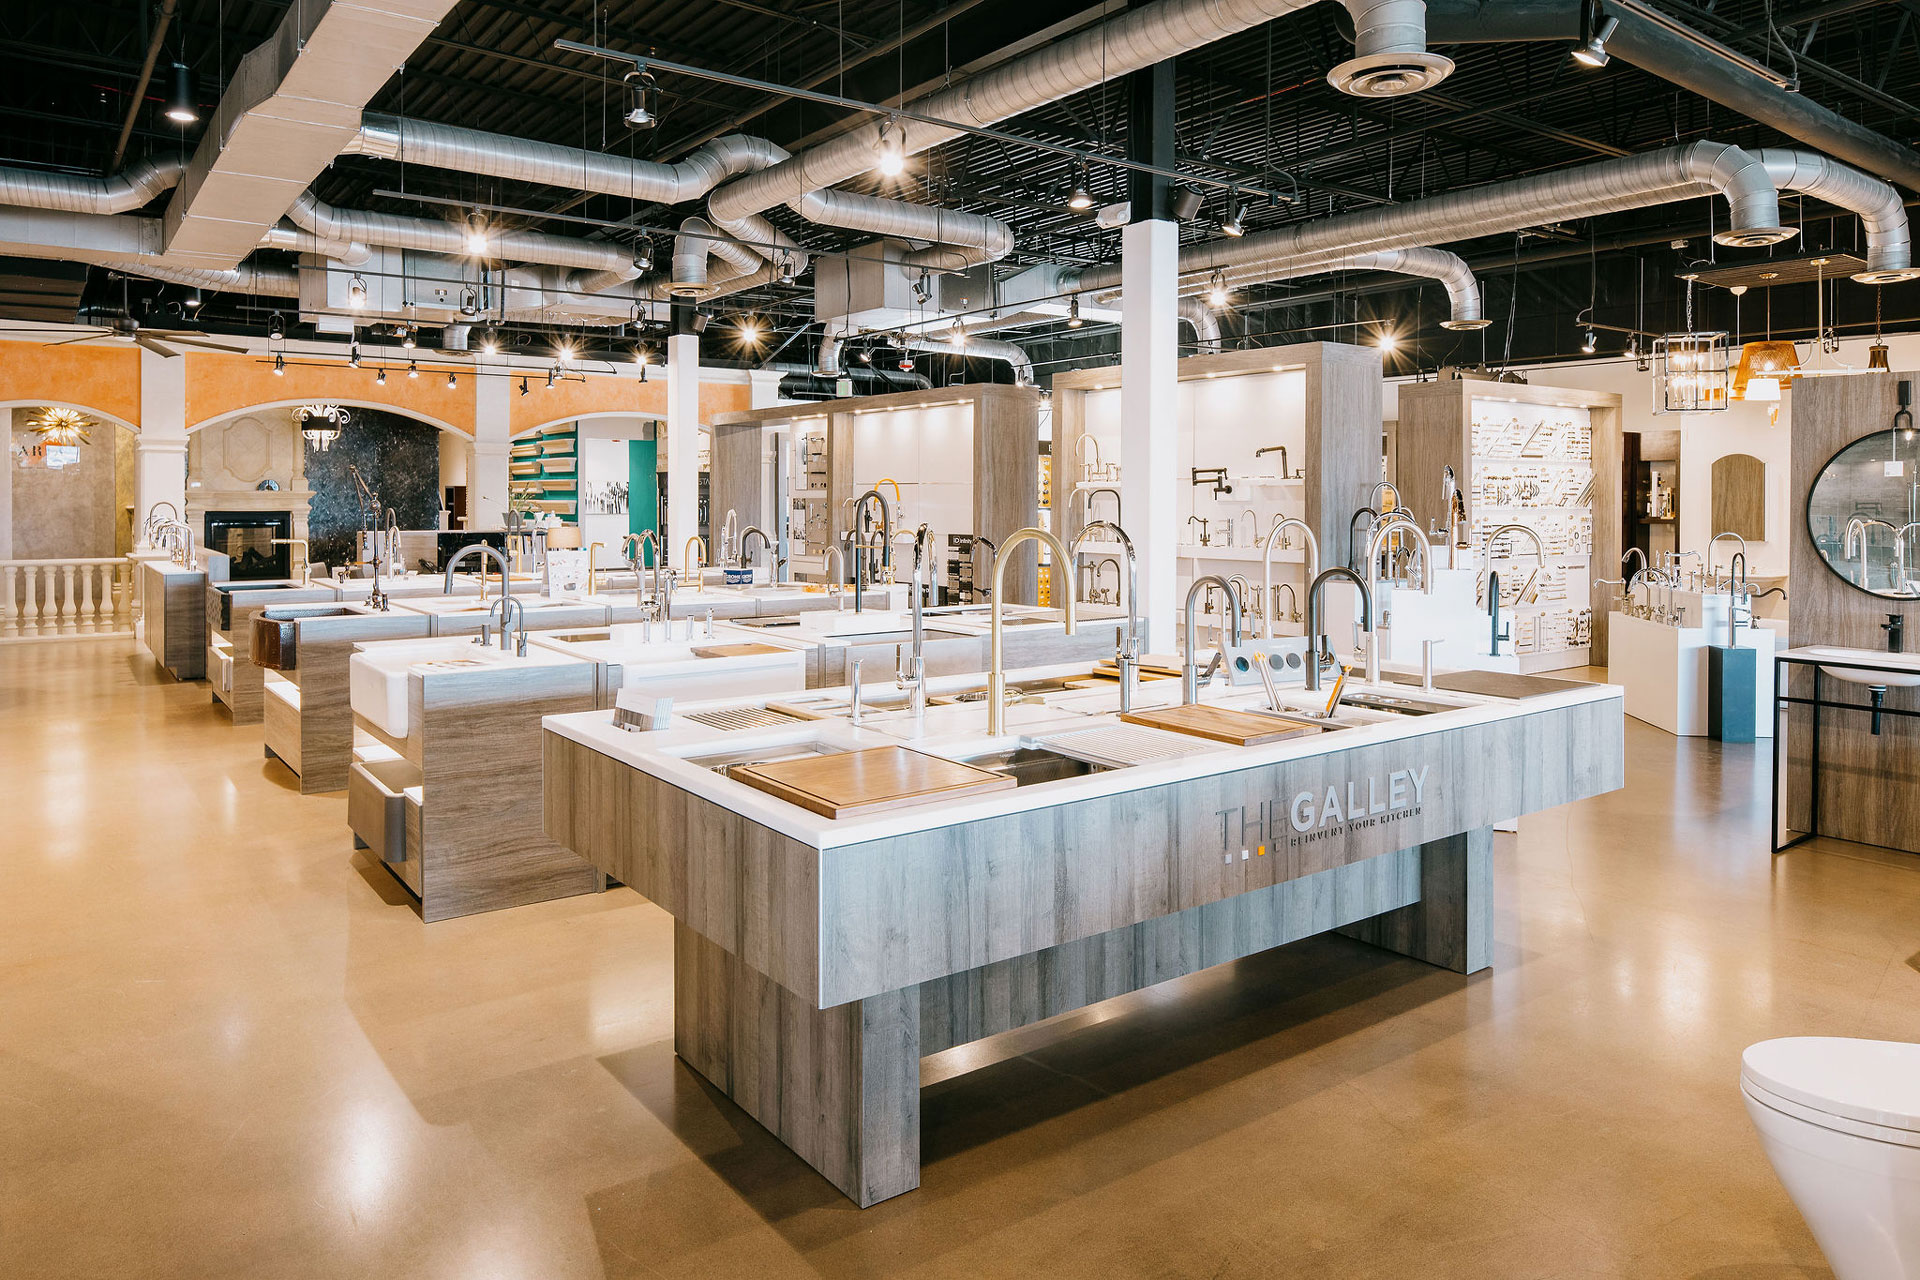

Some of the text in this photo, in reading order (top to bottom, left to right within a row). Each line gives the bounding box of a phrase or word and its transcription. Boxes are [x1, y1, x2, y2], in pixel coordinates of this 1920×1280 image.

[1215, 765, 1430, 850] THE GALLEY
[1349, 818, 1376, 832] YOUR
[1380, 806, 1421, 824] KITCHEN
